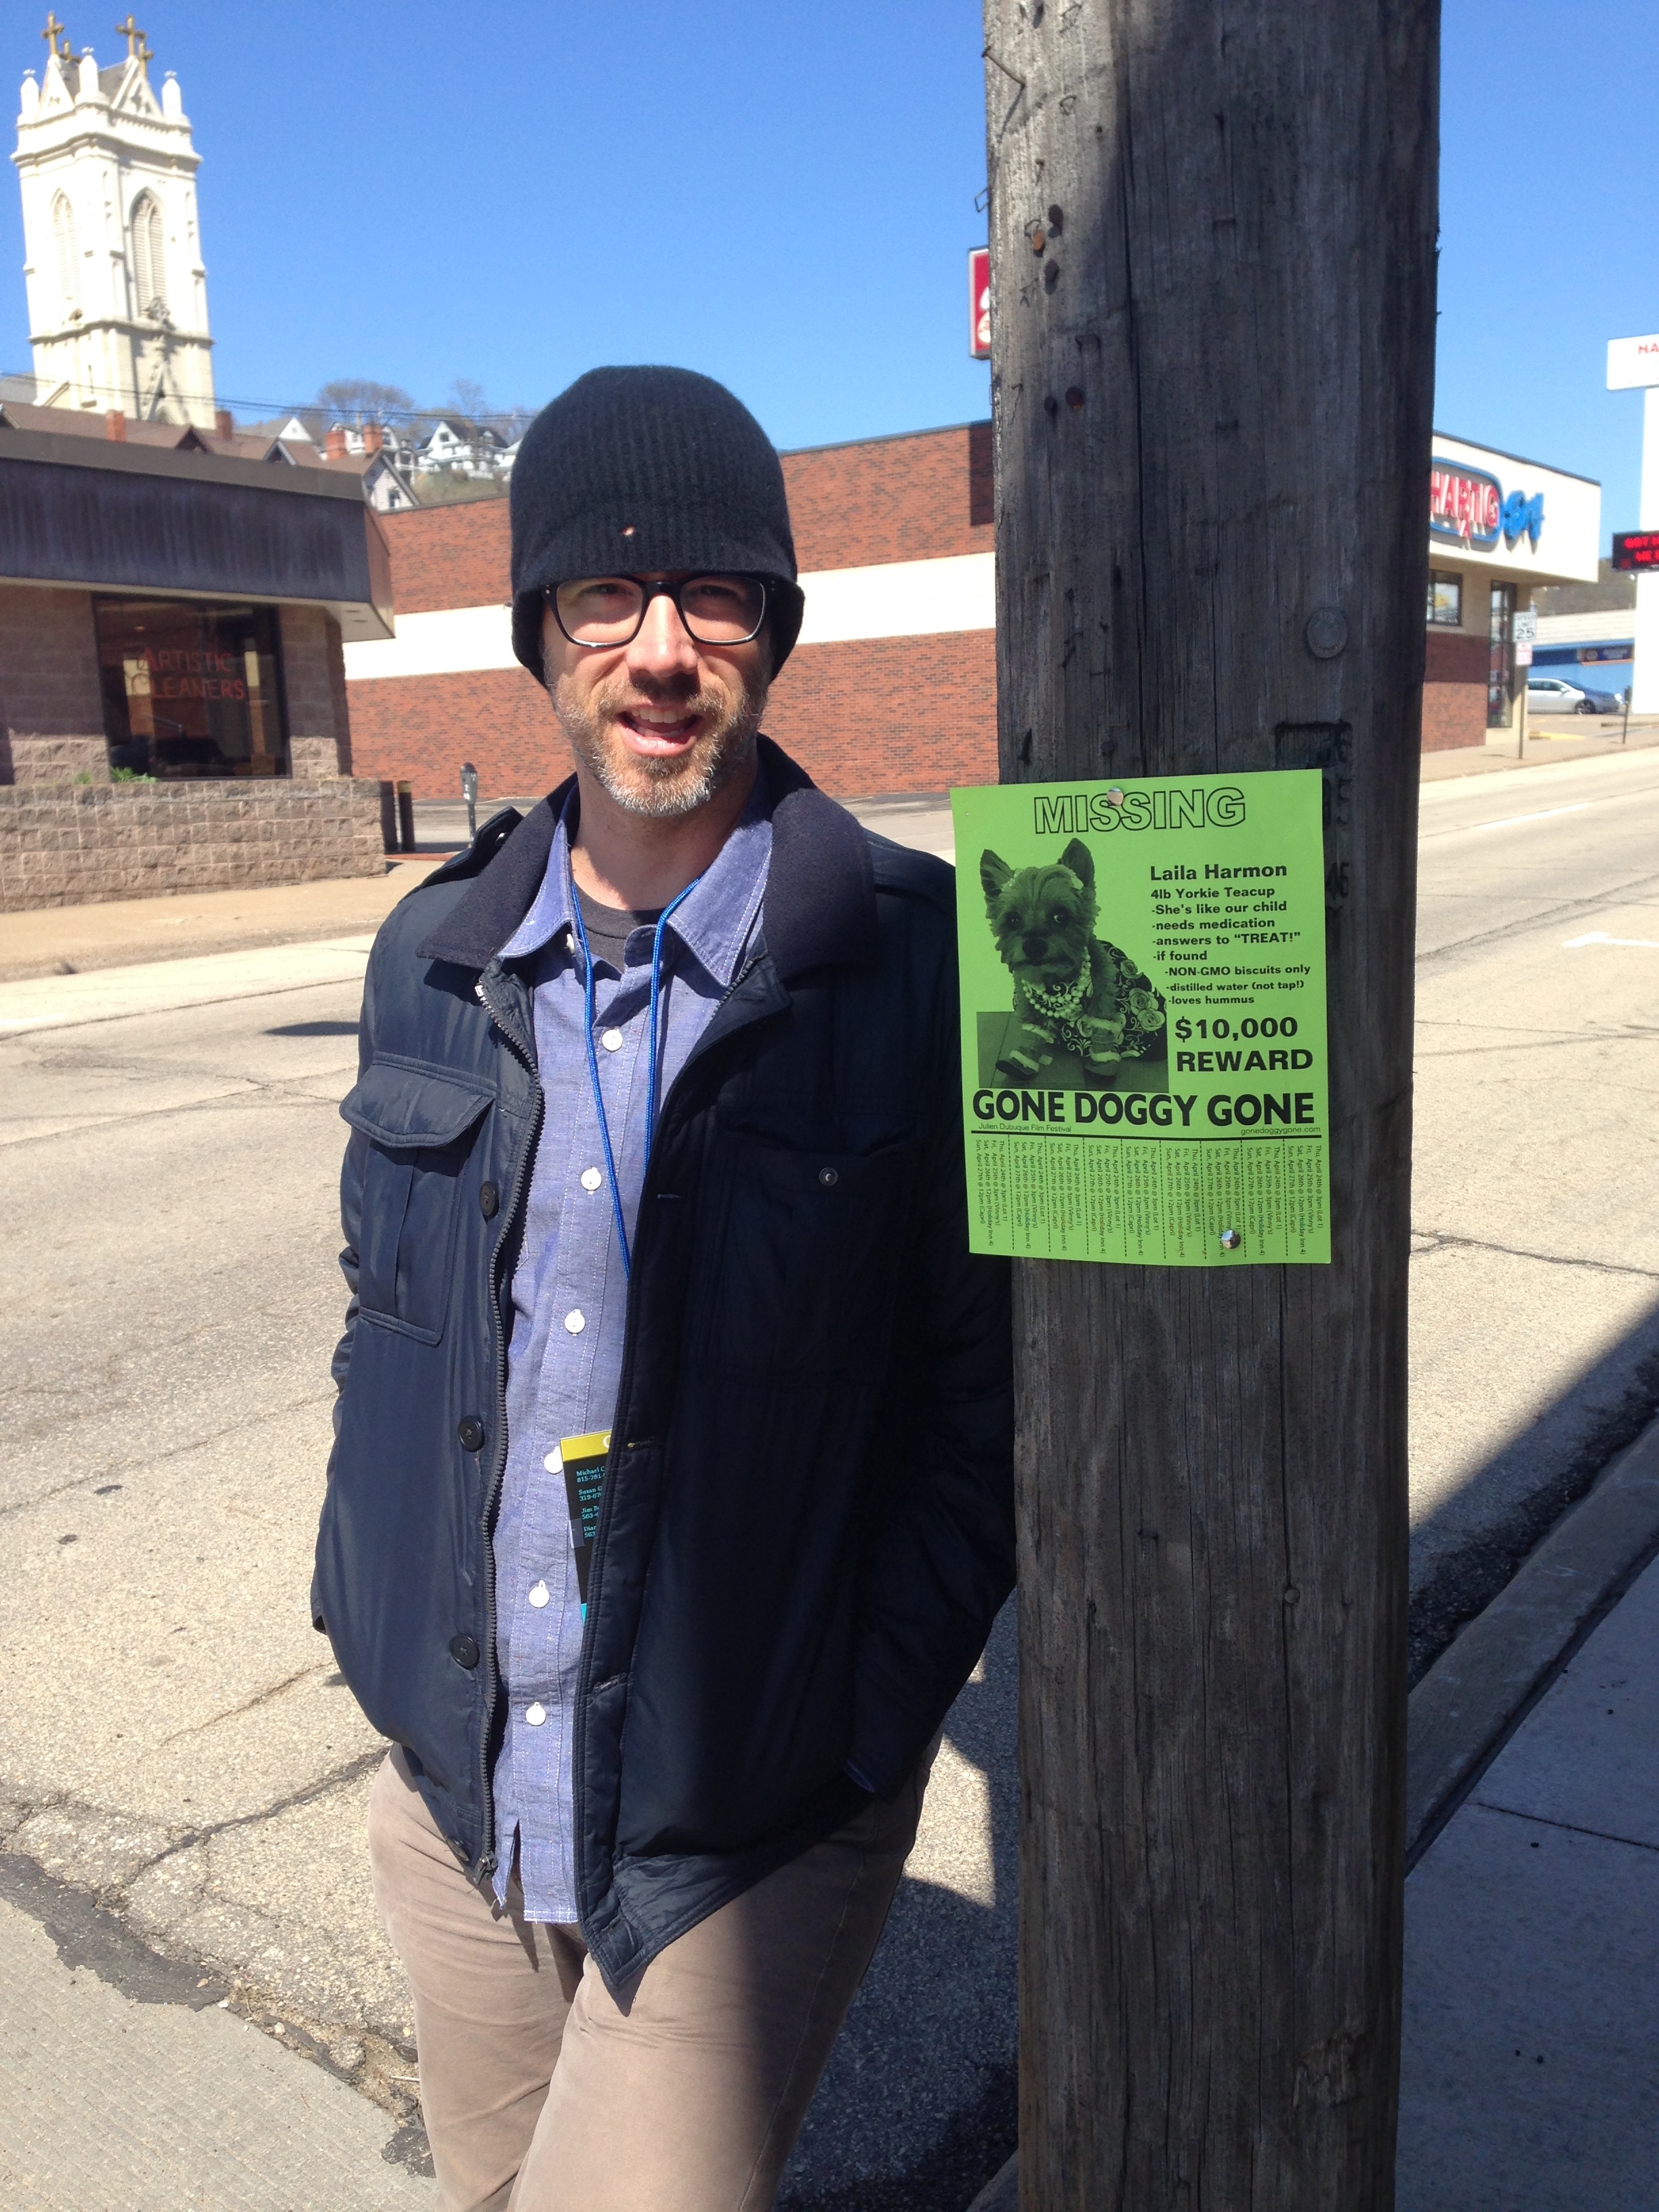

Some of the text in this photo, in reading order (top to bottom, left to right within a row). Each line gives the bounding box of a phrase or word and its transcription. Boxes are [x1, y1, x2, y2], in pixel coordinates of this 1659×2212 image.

[1516, 628, 1534, 639] 25
[138, 647, 232, 672] ARTISTIC
[131, 673, 245, 700] CLEANERS
[1034, 787, 1246, 834] MISSING
[1151, 864, 1286, 880] Laila Harmon
[1151, 887, 1275, 899] 4lb Yorkie Teacup
[1152, 904, 1191, 914] -She's
[1197, 903, 1220, 914] like
[1253, 901, 1286, 912] child
[1152, 918, 1275, 930] -needs medication
[1216, 936, 1229, 944] to
[1153, 950, 1207, 960] -if found
[1165, 964, 1311, 976] -NON-GMO biscuits only
[1166, 983, 1212, 991] -distilled
[1277, 981, 1304, 990] tap!)
[1169, 996, 1254, 1004] -loves hummus
[1175, 1016, 1298, 1042] $10,000
[1177, 1049, 1313, 1071] REWARD
[972, 1089, 1314, 1126] GONE DOGGY GONE
[1000, 1124, 1029, 1132] Dubuque
[1241, 1127, 1321, 1135] gonedoggygone.com
[576, 1467, 599, 1477] Michael
